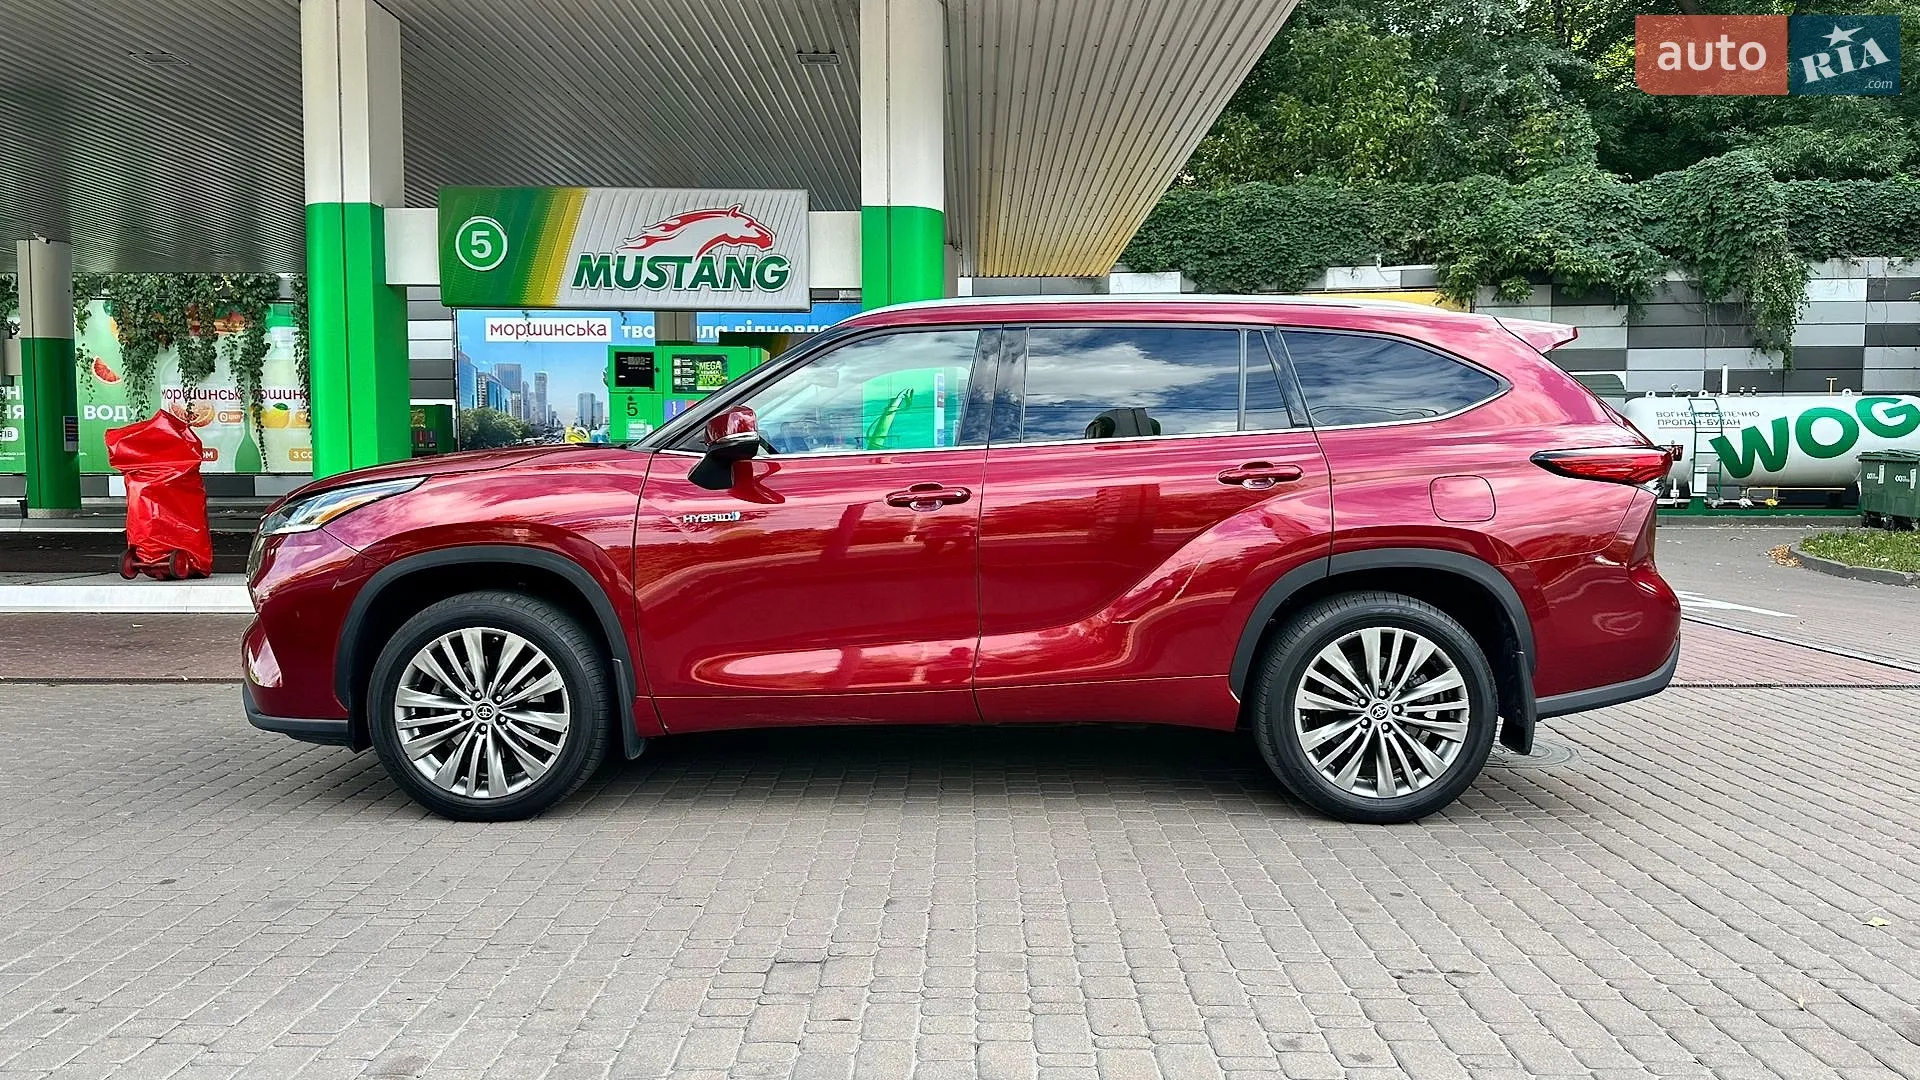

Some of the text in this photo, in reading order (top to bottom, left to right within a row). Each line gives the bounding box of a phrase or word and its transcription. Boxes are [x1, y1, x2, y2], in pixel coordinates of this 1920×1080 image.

[469, 230, 492, 258] 5
[571, 252, 792, 293] MUSTANG
[490, 320, 607, 340] моршинська
[626, 402, 639, 417] 5
[1657, 418, 1741, 426] ПРОПАН-БУТАН
[1709, 397, 1920, 479] WOG
[682, 513, 732, 523] HYBRID
